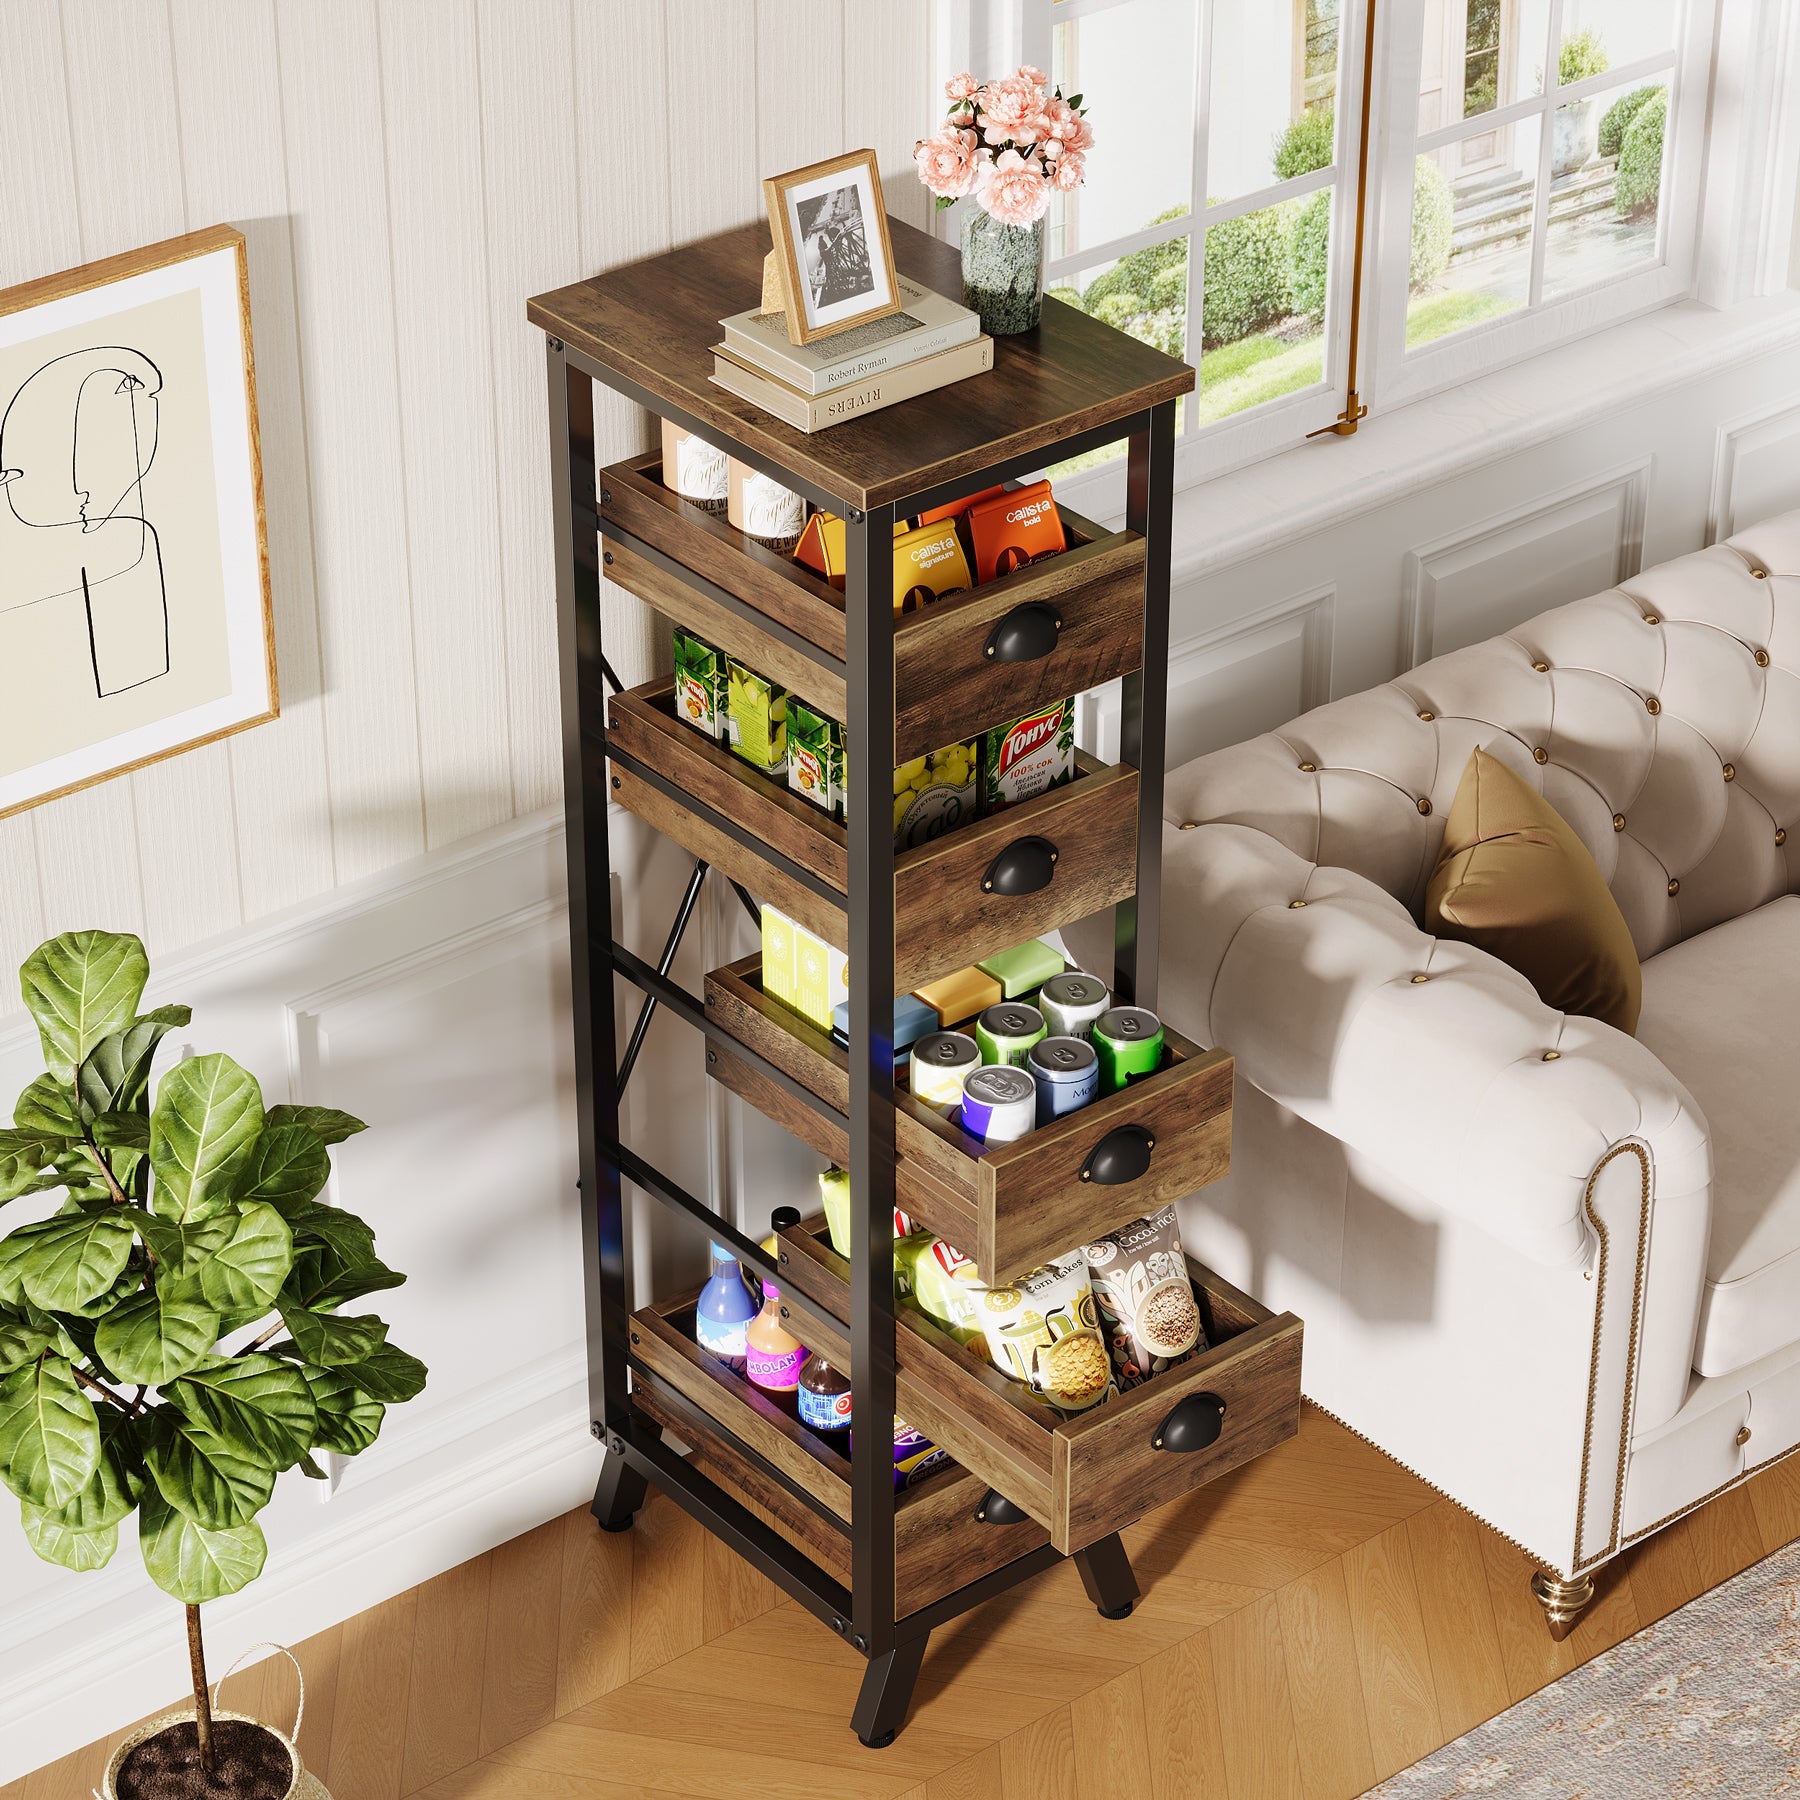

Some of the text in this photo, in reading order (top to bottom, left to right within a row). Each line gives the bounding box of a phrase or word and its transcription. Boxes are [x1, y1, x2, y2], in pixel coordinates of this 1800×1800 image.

[828, 356, 887, 383] Robert Ryman
[828, 388, 881, 417] RIVERS
[1023, 516, 1042, 527] bold
[919, 551, 954, 569] signature
[1010, 763, 1034, 780] 100%
[1118, 1226, 1158, 1248] Cocoa
[1157, 1211, 1176, 1229] rice
[1025, 1259, 1084, 1294] Corn flakes
